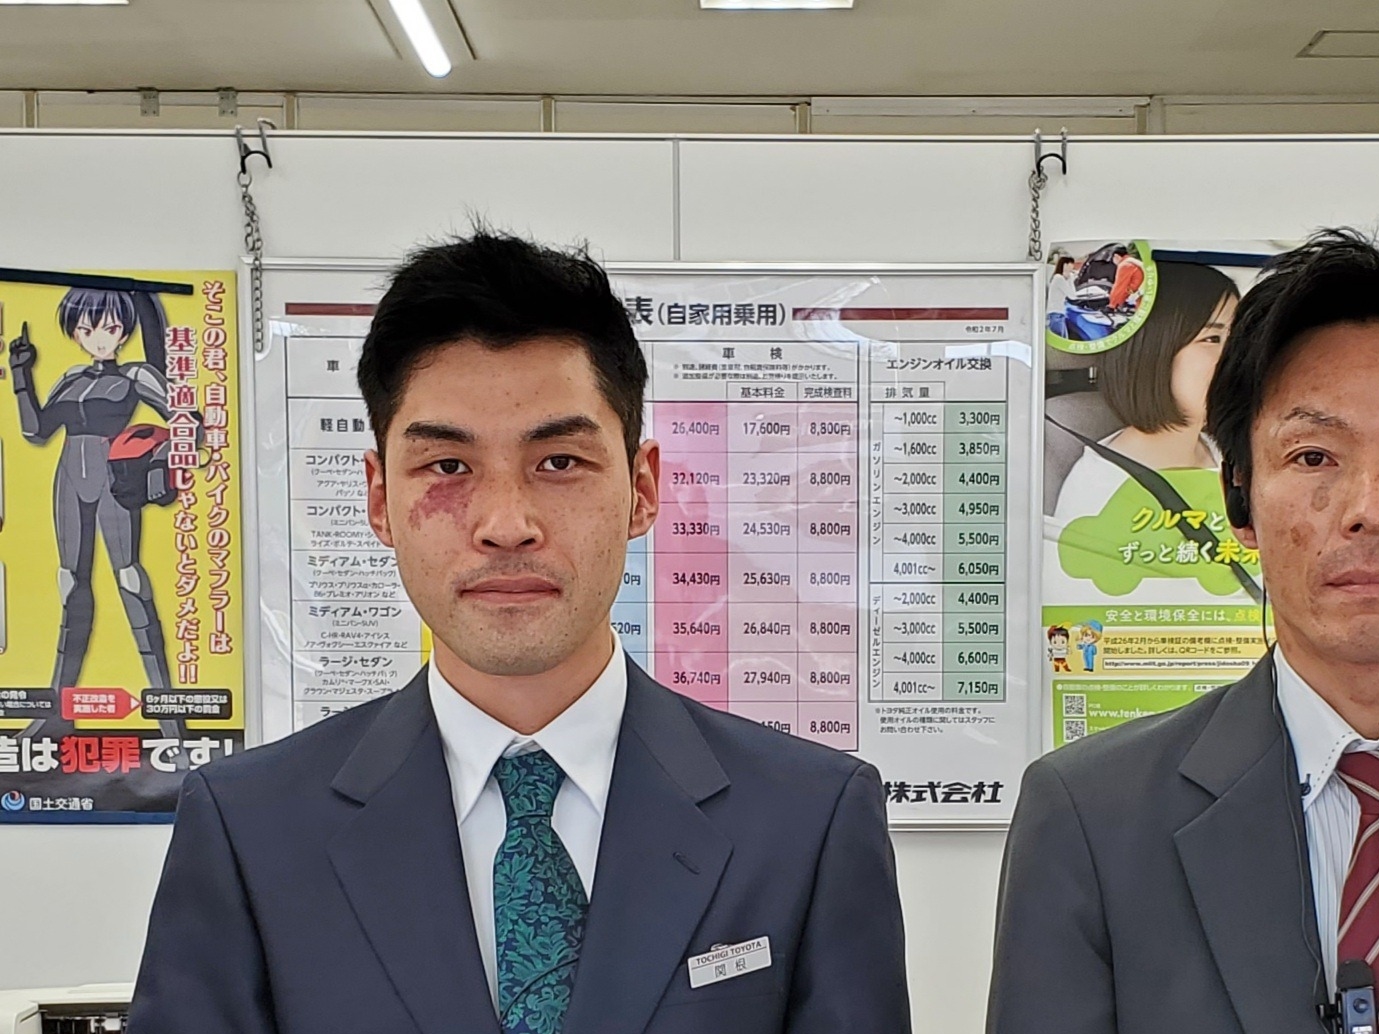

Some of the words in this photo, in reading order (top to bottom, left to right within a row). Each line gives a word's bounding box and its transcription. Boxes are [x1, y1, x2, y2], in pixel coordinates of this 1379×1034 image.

[886, 357, 992, 371] エンジンオイル交換
[741, 387, 785, 398] 基本料金
[804, 387, 852, 398] 完成検査料
[885, 387, 930, 398] 排気量
[321, 418, 372, 432] 軽自動
[959, 412, 1000, 426] 3,300円
[672, 422, 720, 436] 26,400円
[743, 422, 791, 436] 17,600円
[810, 422, 850, 436] 8,800円
[959, 442, 1000, 456] 3,850円
[202, 280, 233, 654] そこの君、自動車・バイクのマフラーは
[672, 472, 720, 486] 32,120円
[743, 472, 791, 486] 23,320円
[810, 472, 850, 486] 8,800円
[959, 472, 1000, 486] 4,400円
[872, 442, 881, 545] ガソリンエンジン
[167, 327, 199, 684] 基準適合品じゃないとダメだよ!!
[959, 502, 999, 516] 4,950円
[672, 523, 720, 537] 33,330円
[743, 523, 791, 537] 24,530円
[810, 523, 850, 537] 8,800円
[958, 532, 999, 546] 5,500円
[958, 562, 999, 576] 6,050円
[672, 573, 720, 586] 34,430円
[743, 573, 791, 586] 25,630円
[810, 573, 850, 586] 8,800円
[958, 592, 999, 606] 4,400円
[309, 606, 401, 617] ミディアム・ワゴン
[673, 622, 721, 636] 35,640円
[743, 622, 791, 636] 26,840円
[810, 622, 850, 636] 8,800円
[958, 622, 999, 636] 5,500円
[872, 595, 881, 688] ディーゼルエンジン
[319, 656, 392, 667] ラージ・セダン
[958, 651, 999, 665] 6,600円
[673, 672, 721, 686] 36,740円
[743, 672, 791, 686] 27,940円
[810, 672, 850, 686] 8,800円
[957, 681, 998, 695] 7,150円
[810, 721, 850, 735] 8,800円
[884, 781, 1004, 803] 株式会社
[29, 797, 94, 811] 国土交通省
[696, 949, 728, 965] TOCHIGI
[731, 941, 761, 956] TOYOTA
